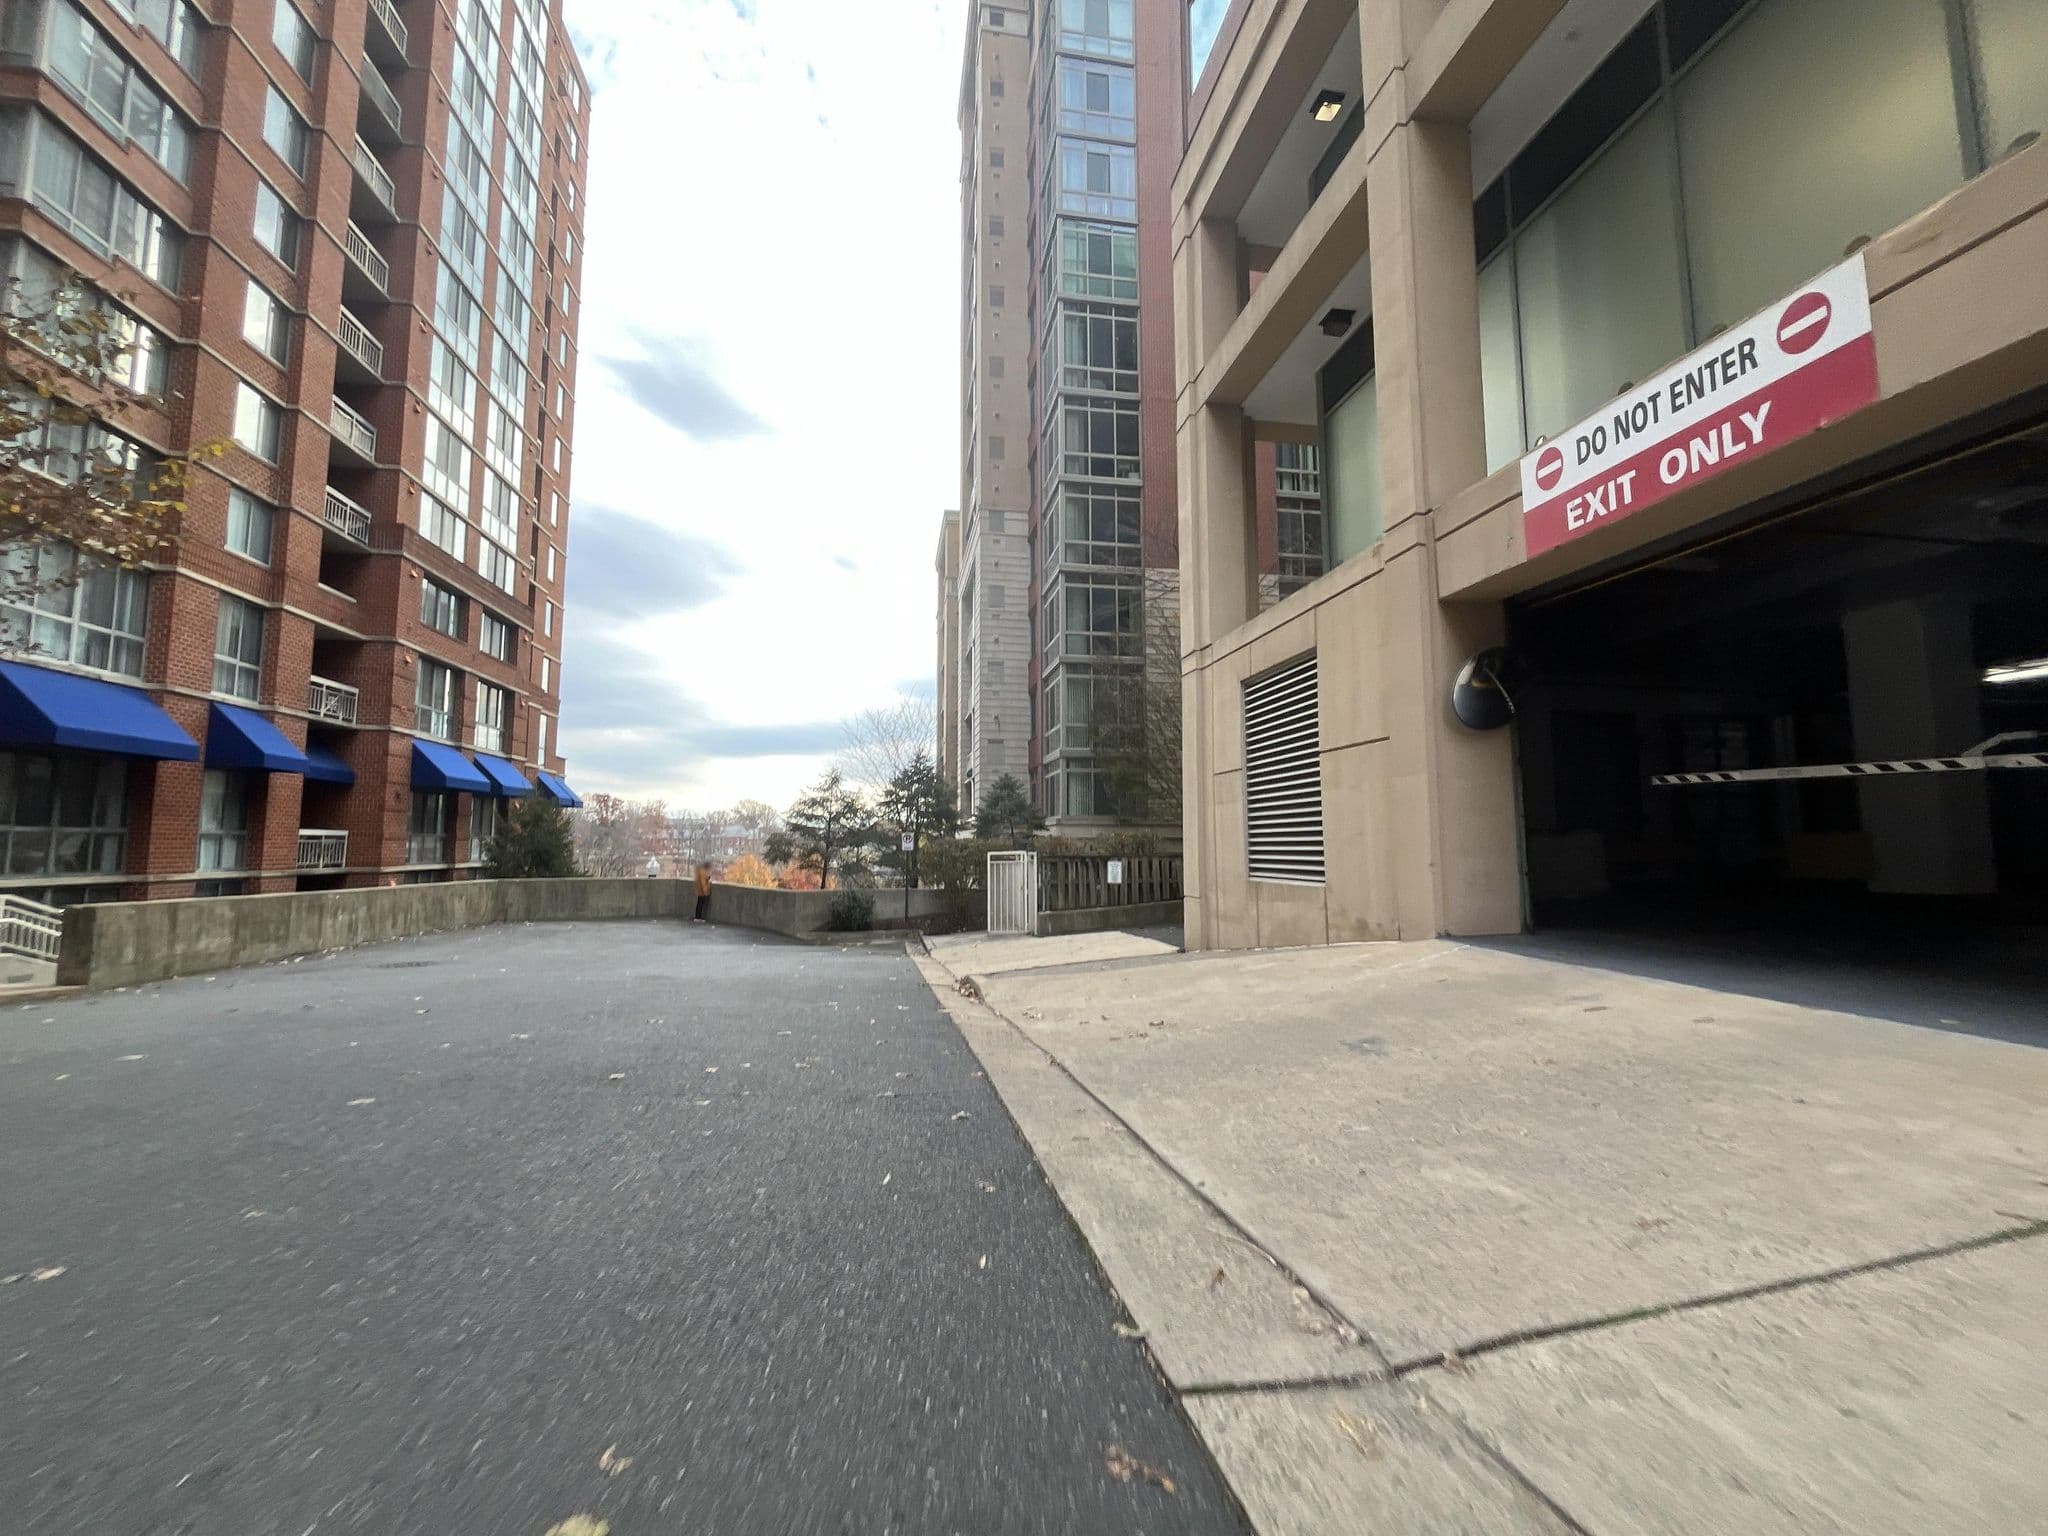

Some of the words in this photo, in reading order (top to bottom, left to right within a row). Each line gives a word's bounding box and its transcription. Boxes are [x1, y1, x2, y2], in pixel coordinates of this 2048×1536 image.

[1576, 426, 1607, 465] DO
[1614, 391, 1661, 444] NOT
[1670, 338, 1758, 414] ENTER
[1567, 470, 1636, 531] EXIT
[1659, 401, 1772, 485] ONLY
